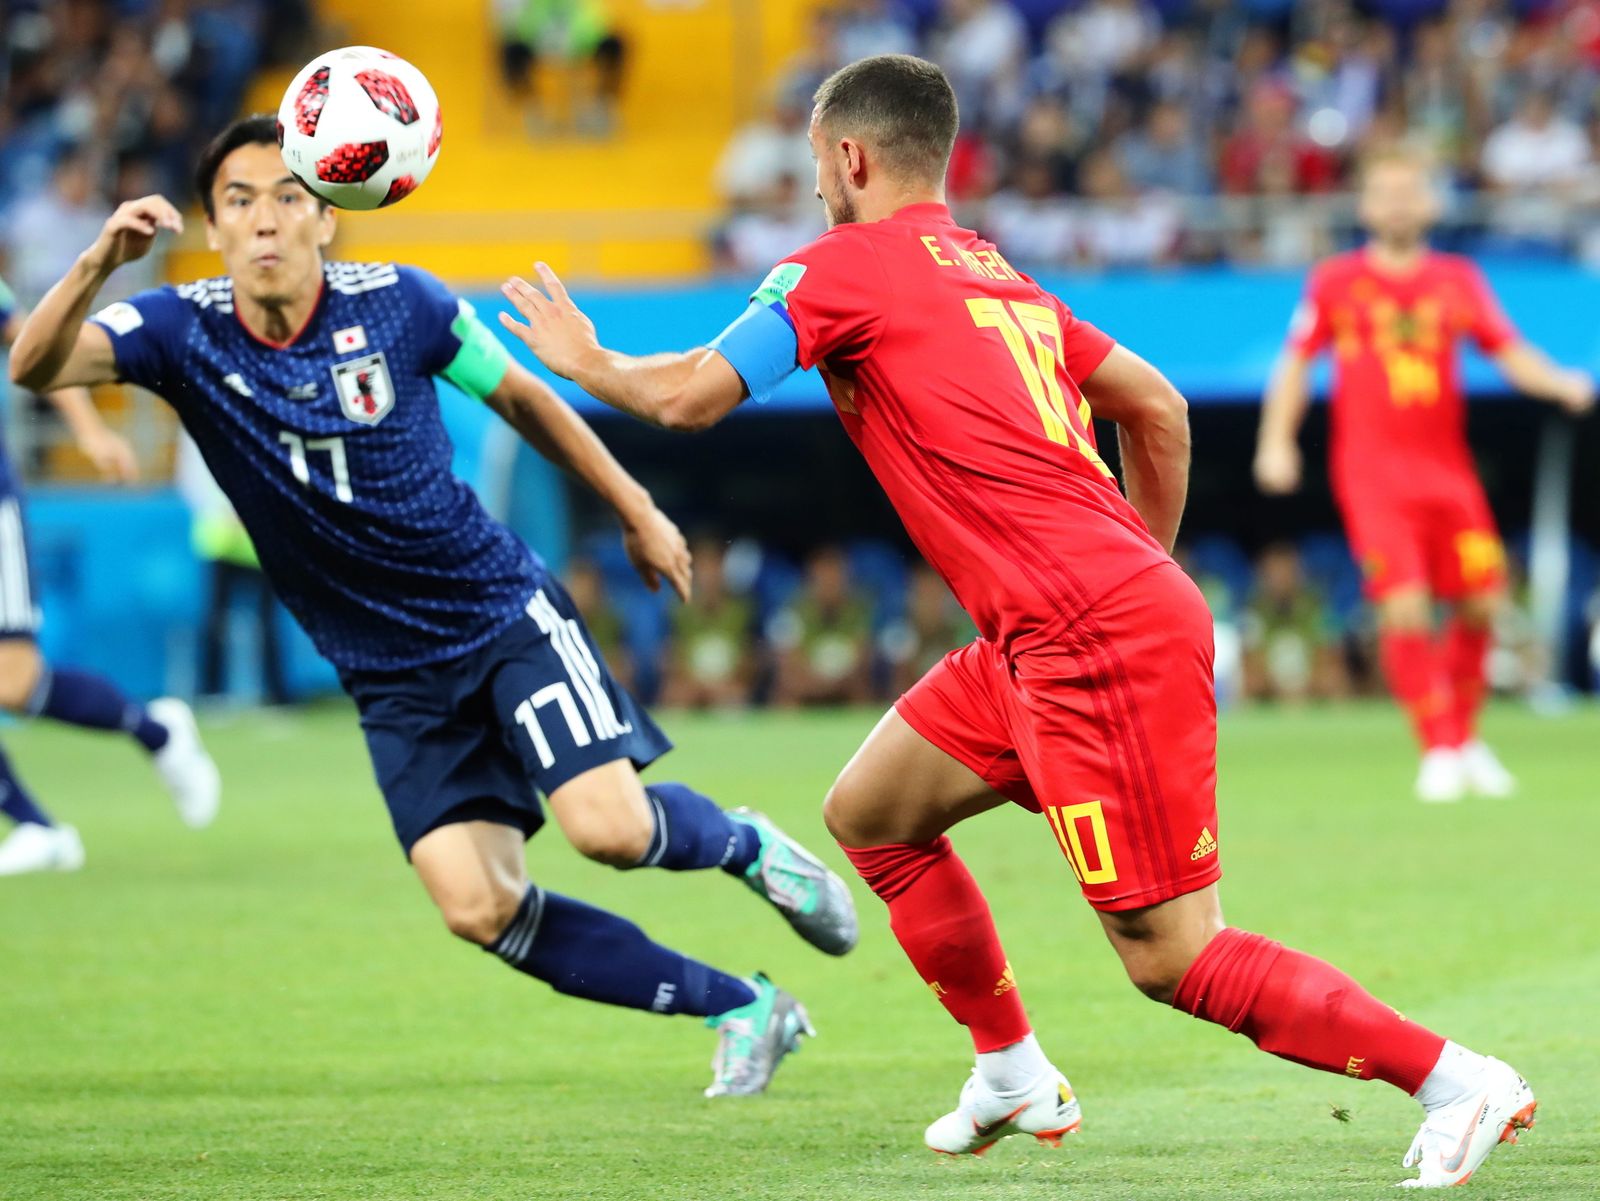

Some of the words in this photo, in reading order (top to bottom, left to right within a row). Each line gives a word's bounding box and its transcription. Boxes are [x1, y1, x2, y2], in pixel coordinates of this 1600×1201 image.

[964, 297, 1116, 479] 10
[278, 431, 354, 504] 17
[513, 681, 592, 770] 17
[1047, 799, 1119, 885] 10
